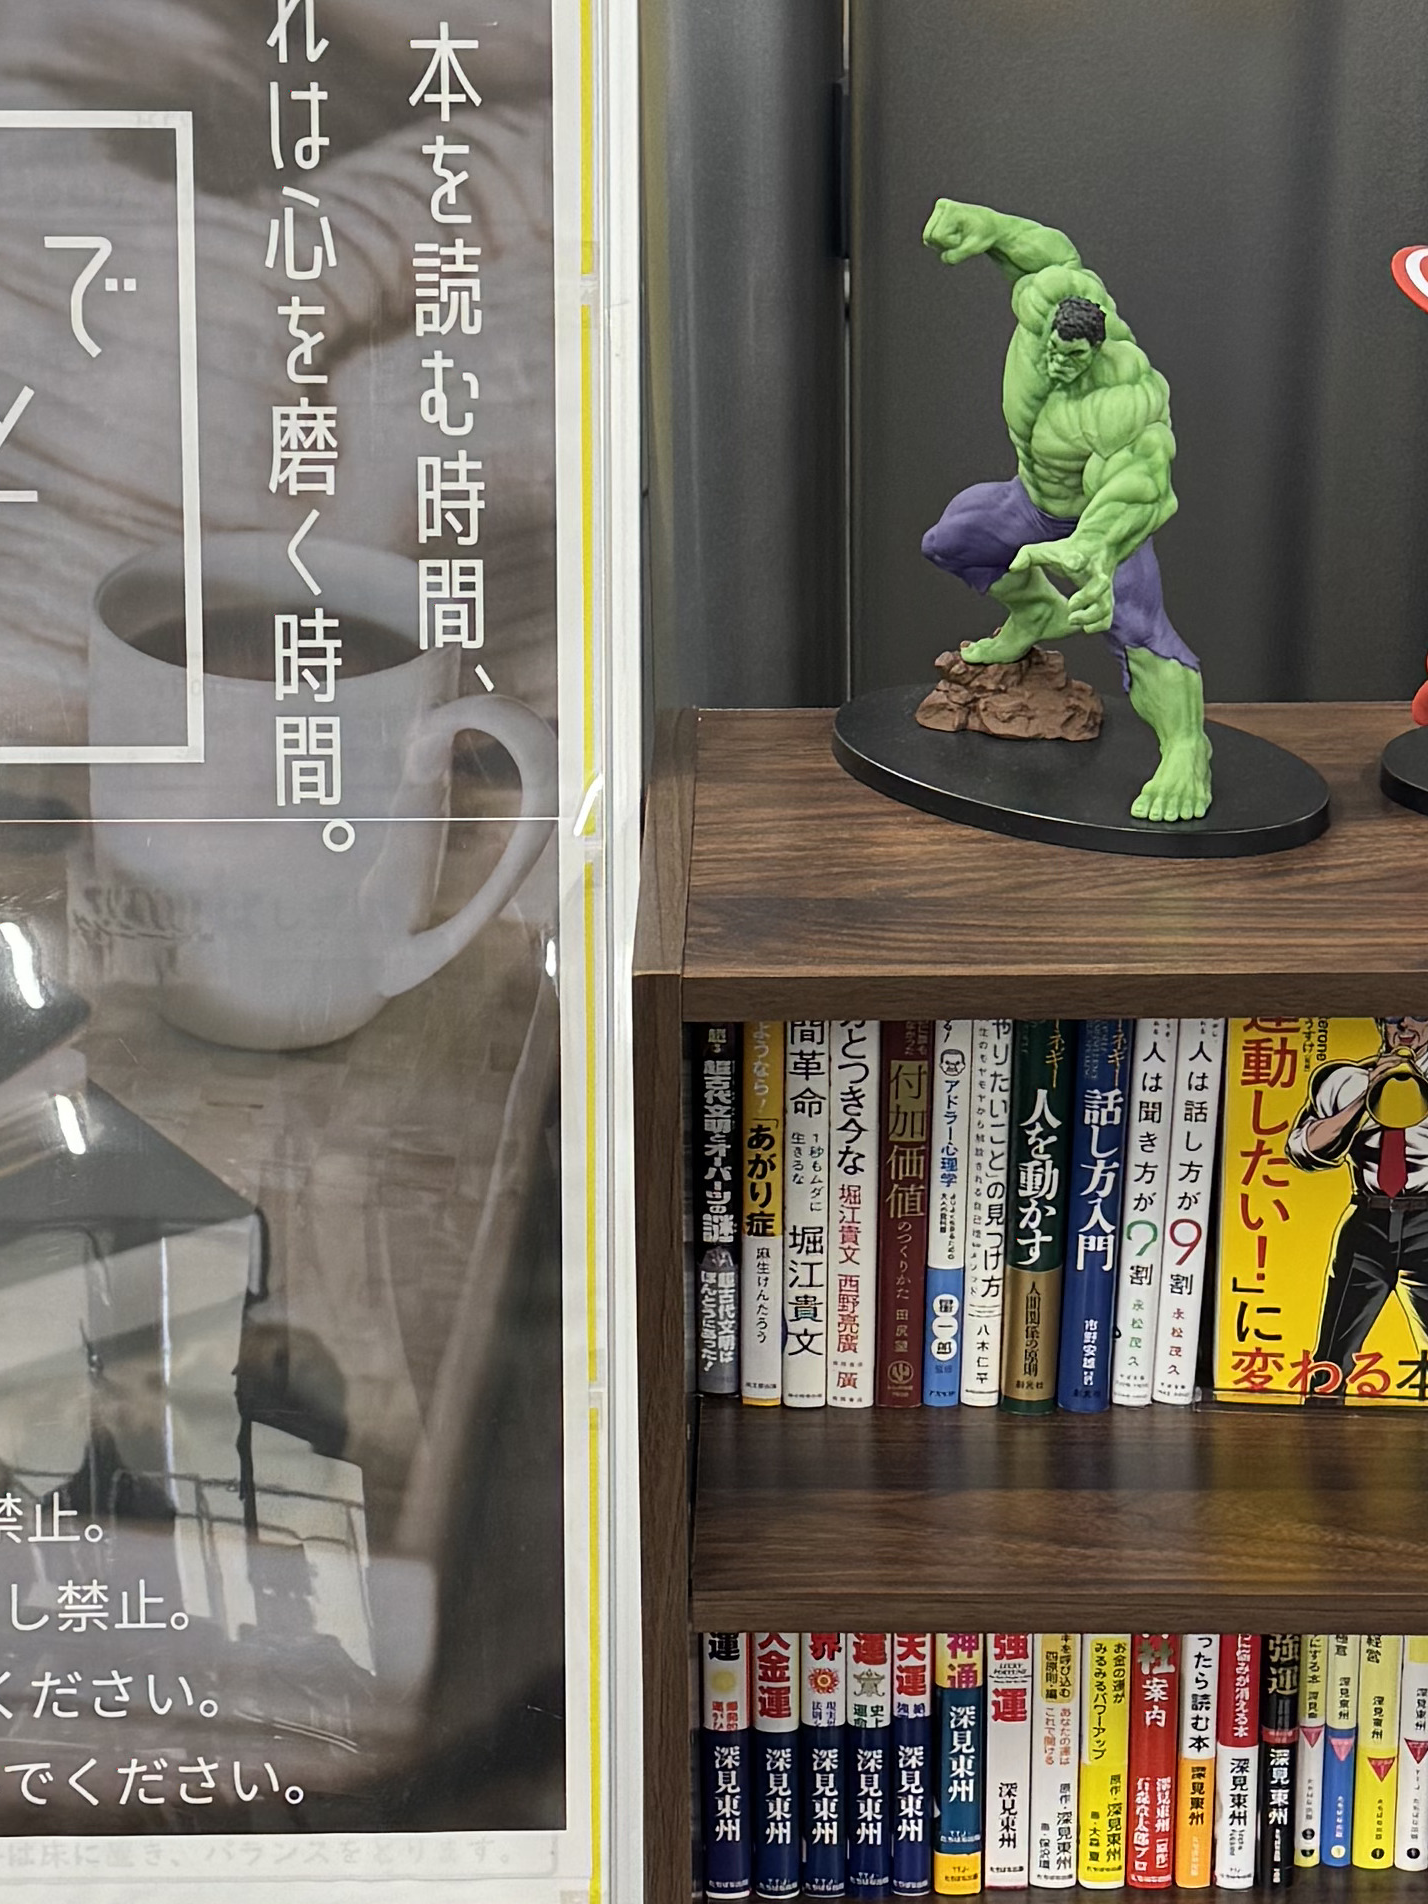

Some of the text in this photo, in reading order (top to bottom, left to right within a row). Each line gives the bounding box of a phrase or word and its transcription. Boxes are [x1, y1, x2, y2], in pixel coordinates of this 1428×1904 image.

[408, 22, 494, 692] 本を読む時間、
[940, 1079, 961, 1188] アドラー心理学
[1017, 1088, 1062, 1266] 人を動かす
[1076, 1089, 1125, 1272] 話し方入門
[1168, 1040, 1213, 1296] 人は話し方が9割
[838, 1184, 862, 1266] 堀江貴文
[788, 1225, 824, 1357] 堀江貴文
[991, 1688, 1028, 1722] 運
[1093, 1643, 1107, 1761] みるみるパワーアップ
[1112, 1642, 1127, 1704] お金の運が
[1188, 1636, 1213, 1752] ったら読む本
[714, 1746, 741, 1842] 深見東州
[765, 1748, 791, 1845] 深見東州
[812, 1748, 838, 1845] 深見東州
[857, 1748, 882, 1845] 深見東州
[898, 1745, 924, 1842] 深見東州
[948, 1706, 976, 1803] 深見東州
[1188, 1767, 1206, 1827] 深見東州
[1229, 1758, 1251, 1827] 深見東州
[1268, 1749, 1290, 1827] 深見東州
[998, 1782, 1018, 1849] 深見東州
